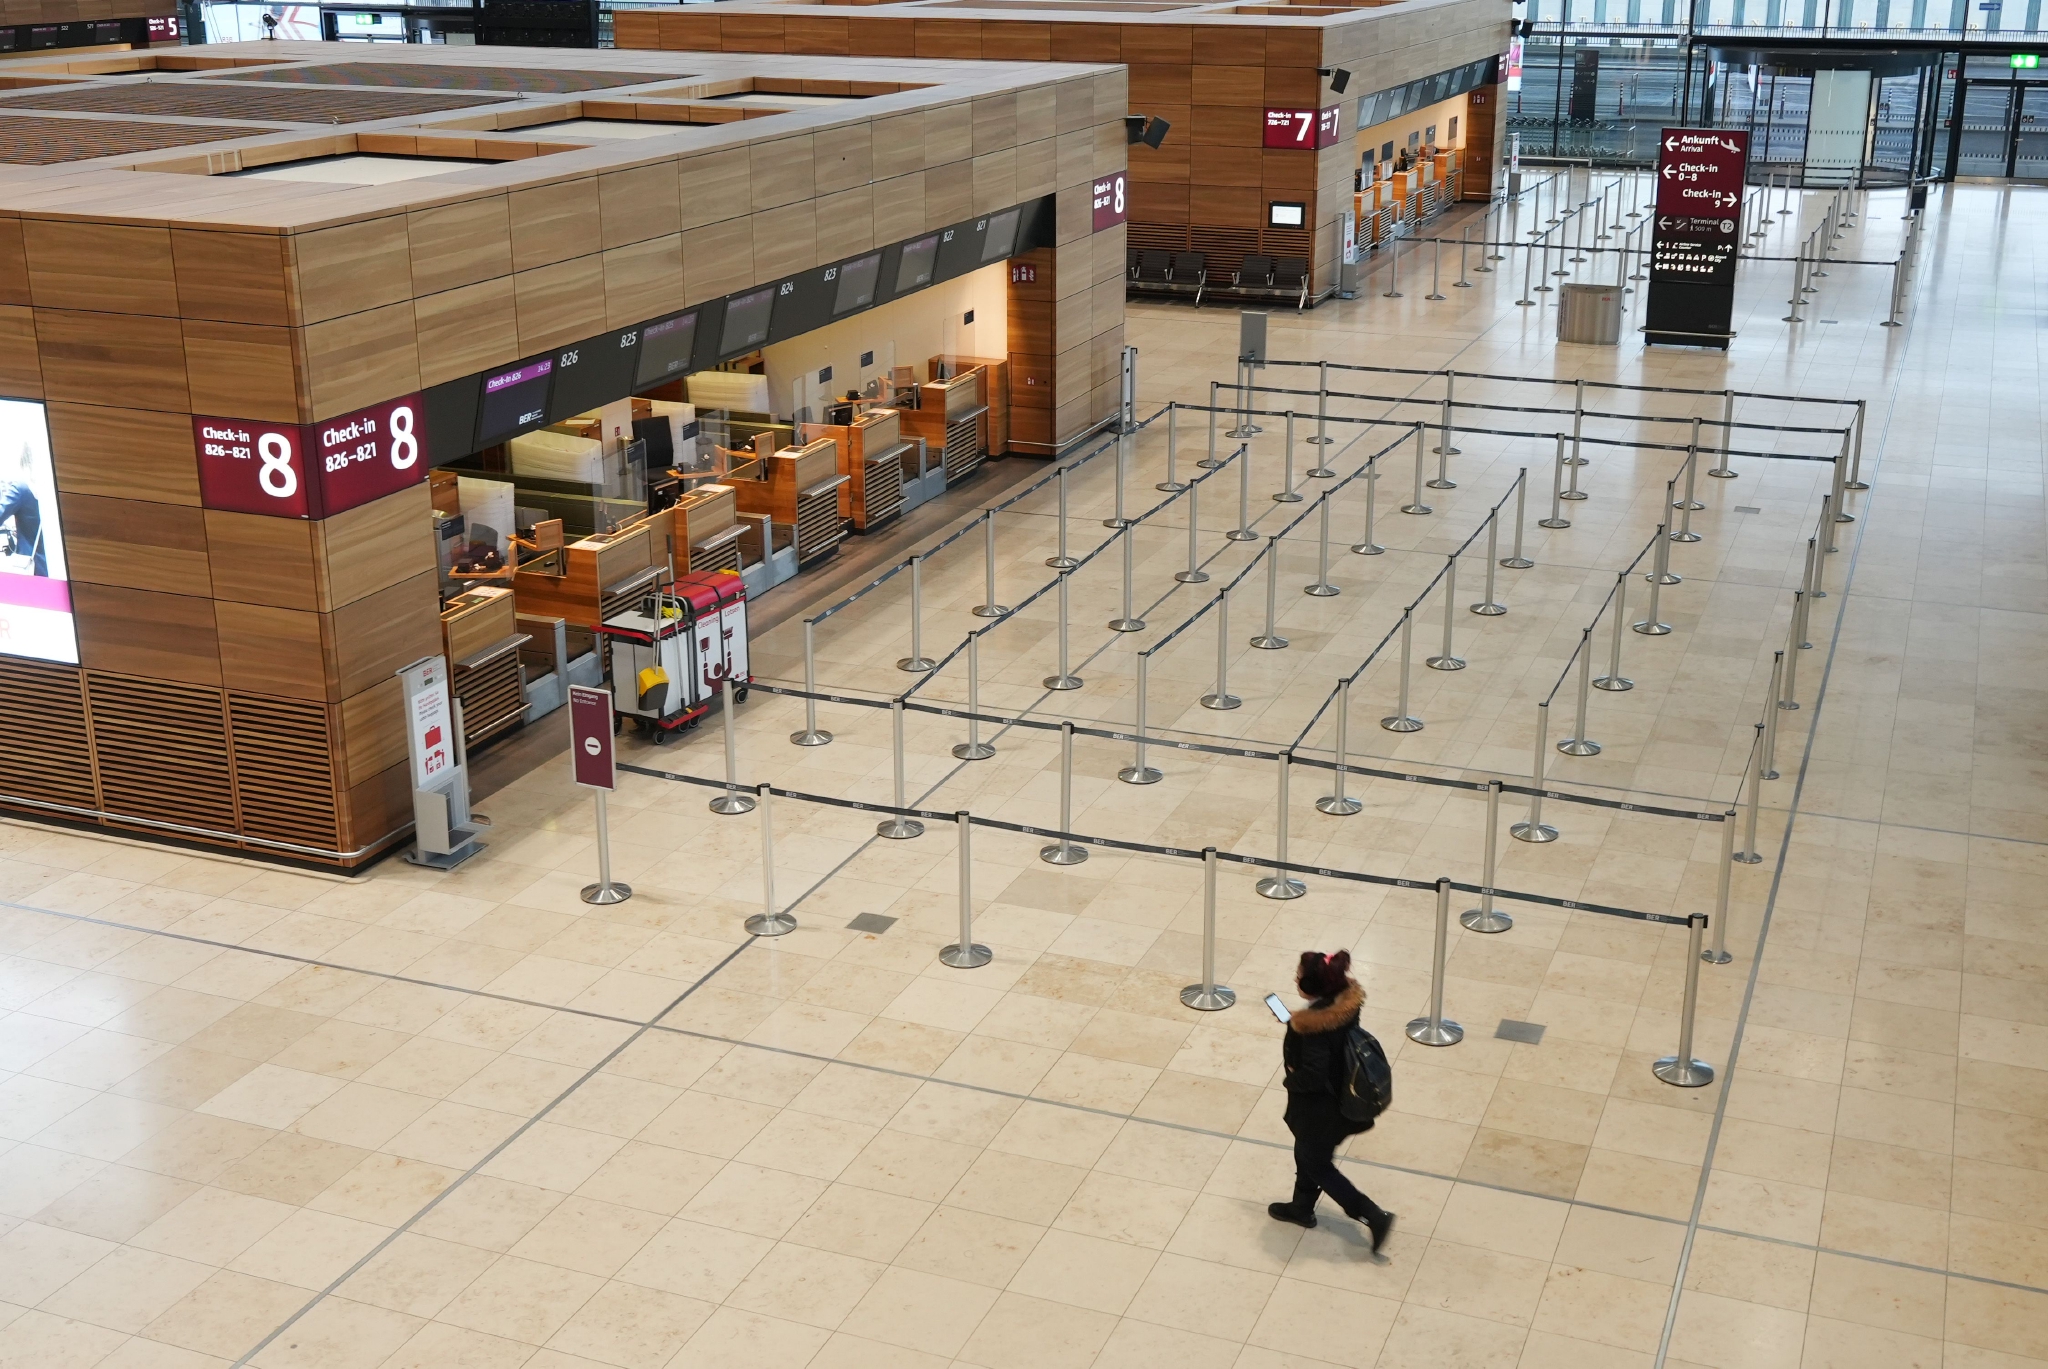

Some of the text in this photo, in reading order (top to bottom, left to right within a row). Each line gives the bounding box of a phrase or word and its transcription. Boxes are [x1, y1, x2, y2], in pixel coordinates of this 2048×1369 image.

[168, 18, 177, 35] 5
[1295, 113, 1312, 141] 7
[1333, 108, 1339, 136] 7
[1681, 135, 1719, 145] Ankunft
[1680, 145, 1703, 153] Arrival
[1679, 163, 1718, 172] Check-in
[1678, 173, 1697, 181] 0–8
[1115, 177, 1124, 213] 8
[1682, 189, 1721, 198] Check-in
[1714, 200, 1720, 208] 9
[824, 268, 837, 281] 823
[781, 282, 794, 295] 824
[620, 331, 637, 348] 825
[560, 350, 579, 367] 826
[512, 371, 522, 381] 826
[519, 412, 532, 425] BER
[203, 427, 250, 442] Check-in
[323, 418, 376, 447] Check-in
[390, 407, 418, 470] 8
[205, 444, 251, 459] 826–821
[326, 442, 377, 472] 826–821
[258, 433, 297, 497] 8
[724, 606, 740, 617] Lotsen
[697, 616, 720, 629] Cleaning
[423, 667, 433, 677] BER
[1547, 791, 1559, 799] BER
[1094, 838, 1105, 846] BER
[1319, 868, 1331, 876] BER
[1563, 901, 1576, 909] BER
[1646, 913, 1660, 921] BER
